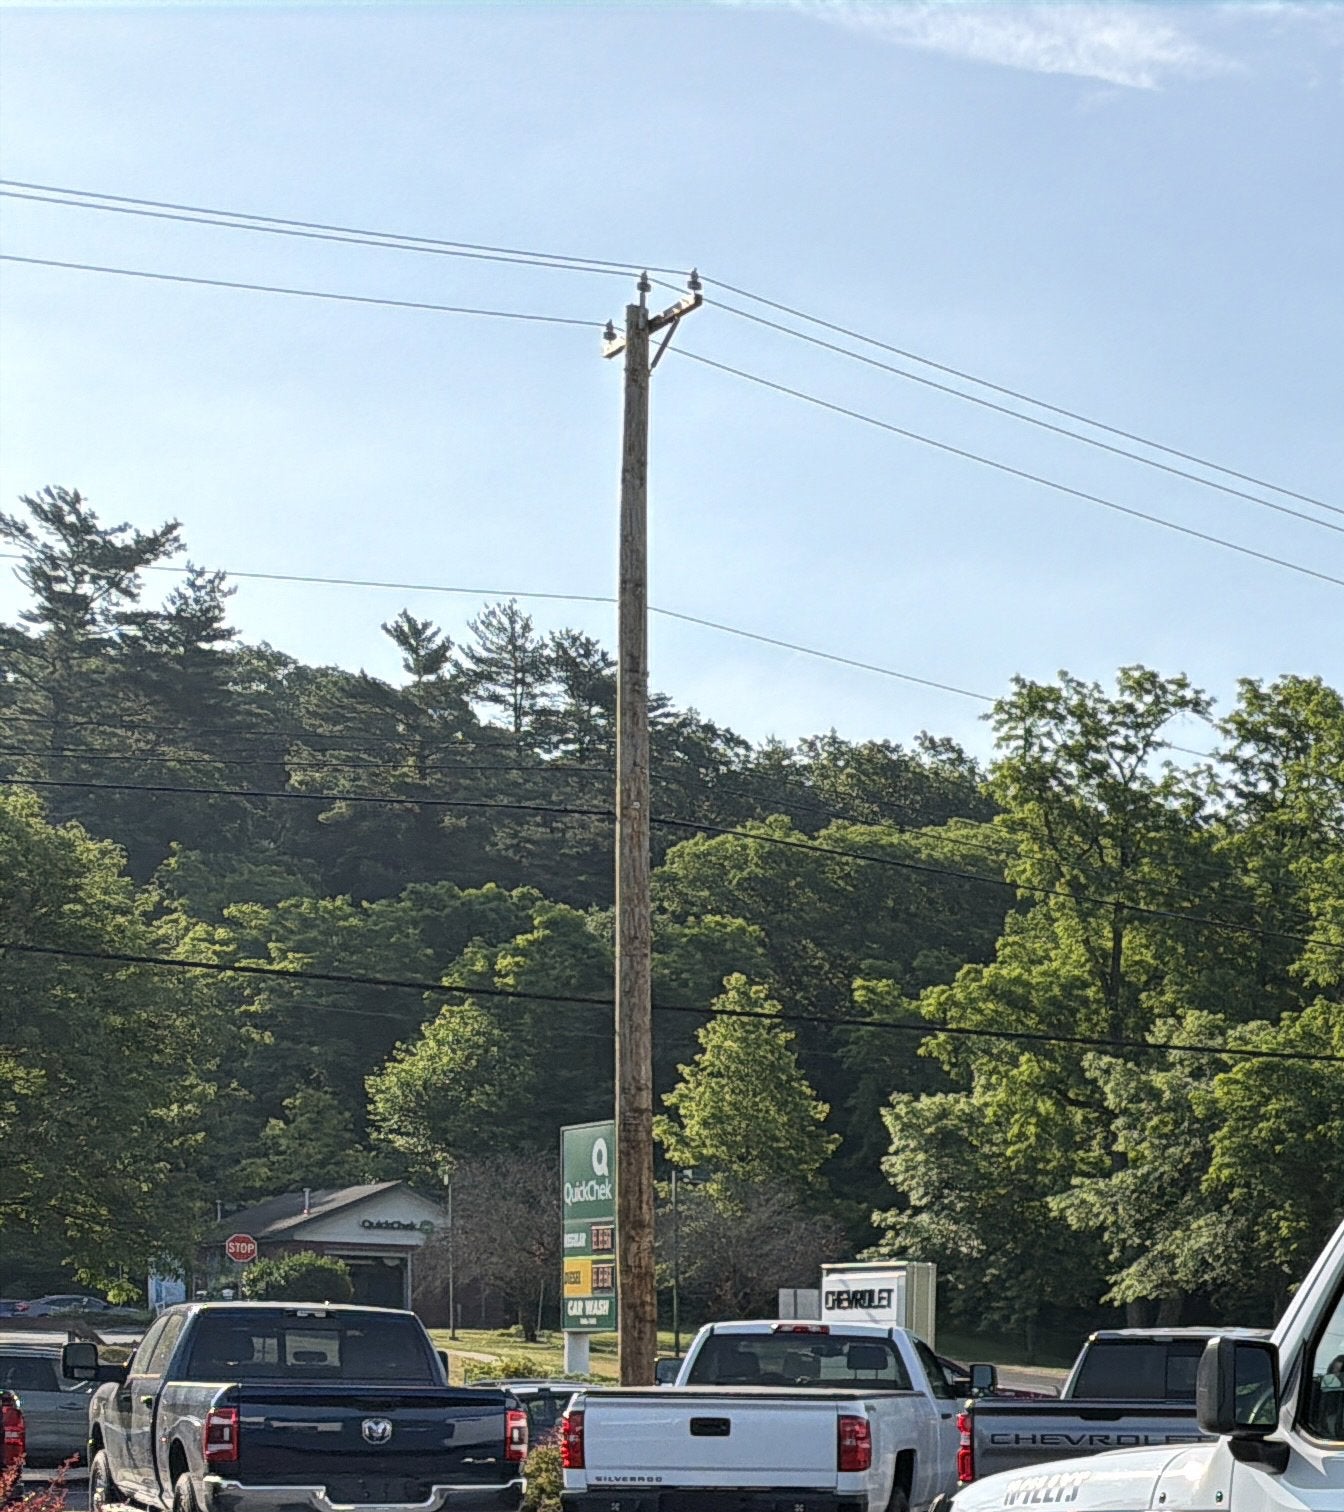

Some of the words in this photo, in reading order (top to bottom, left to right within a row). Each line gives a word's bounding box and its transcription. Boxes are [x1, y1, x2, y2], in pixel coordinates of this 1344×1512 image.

[564, 1179, 612, 1205] QuickChek
[228, 1242, 254, 1254] STOP
[567, 1300, 583, 1316] CAR
[585, 1299, 609, 1316] WASH
[825, 1288, 894, 1310] CHEVROLET
